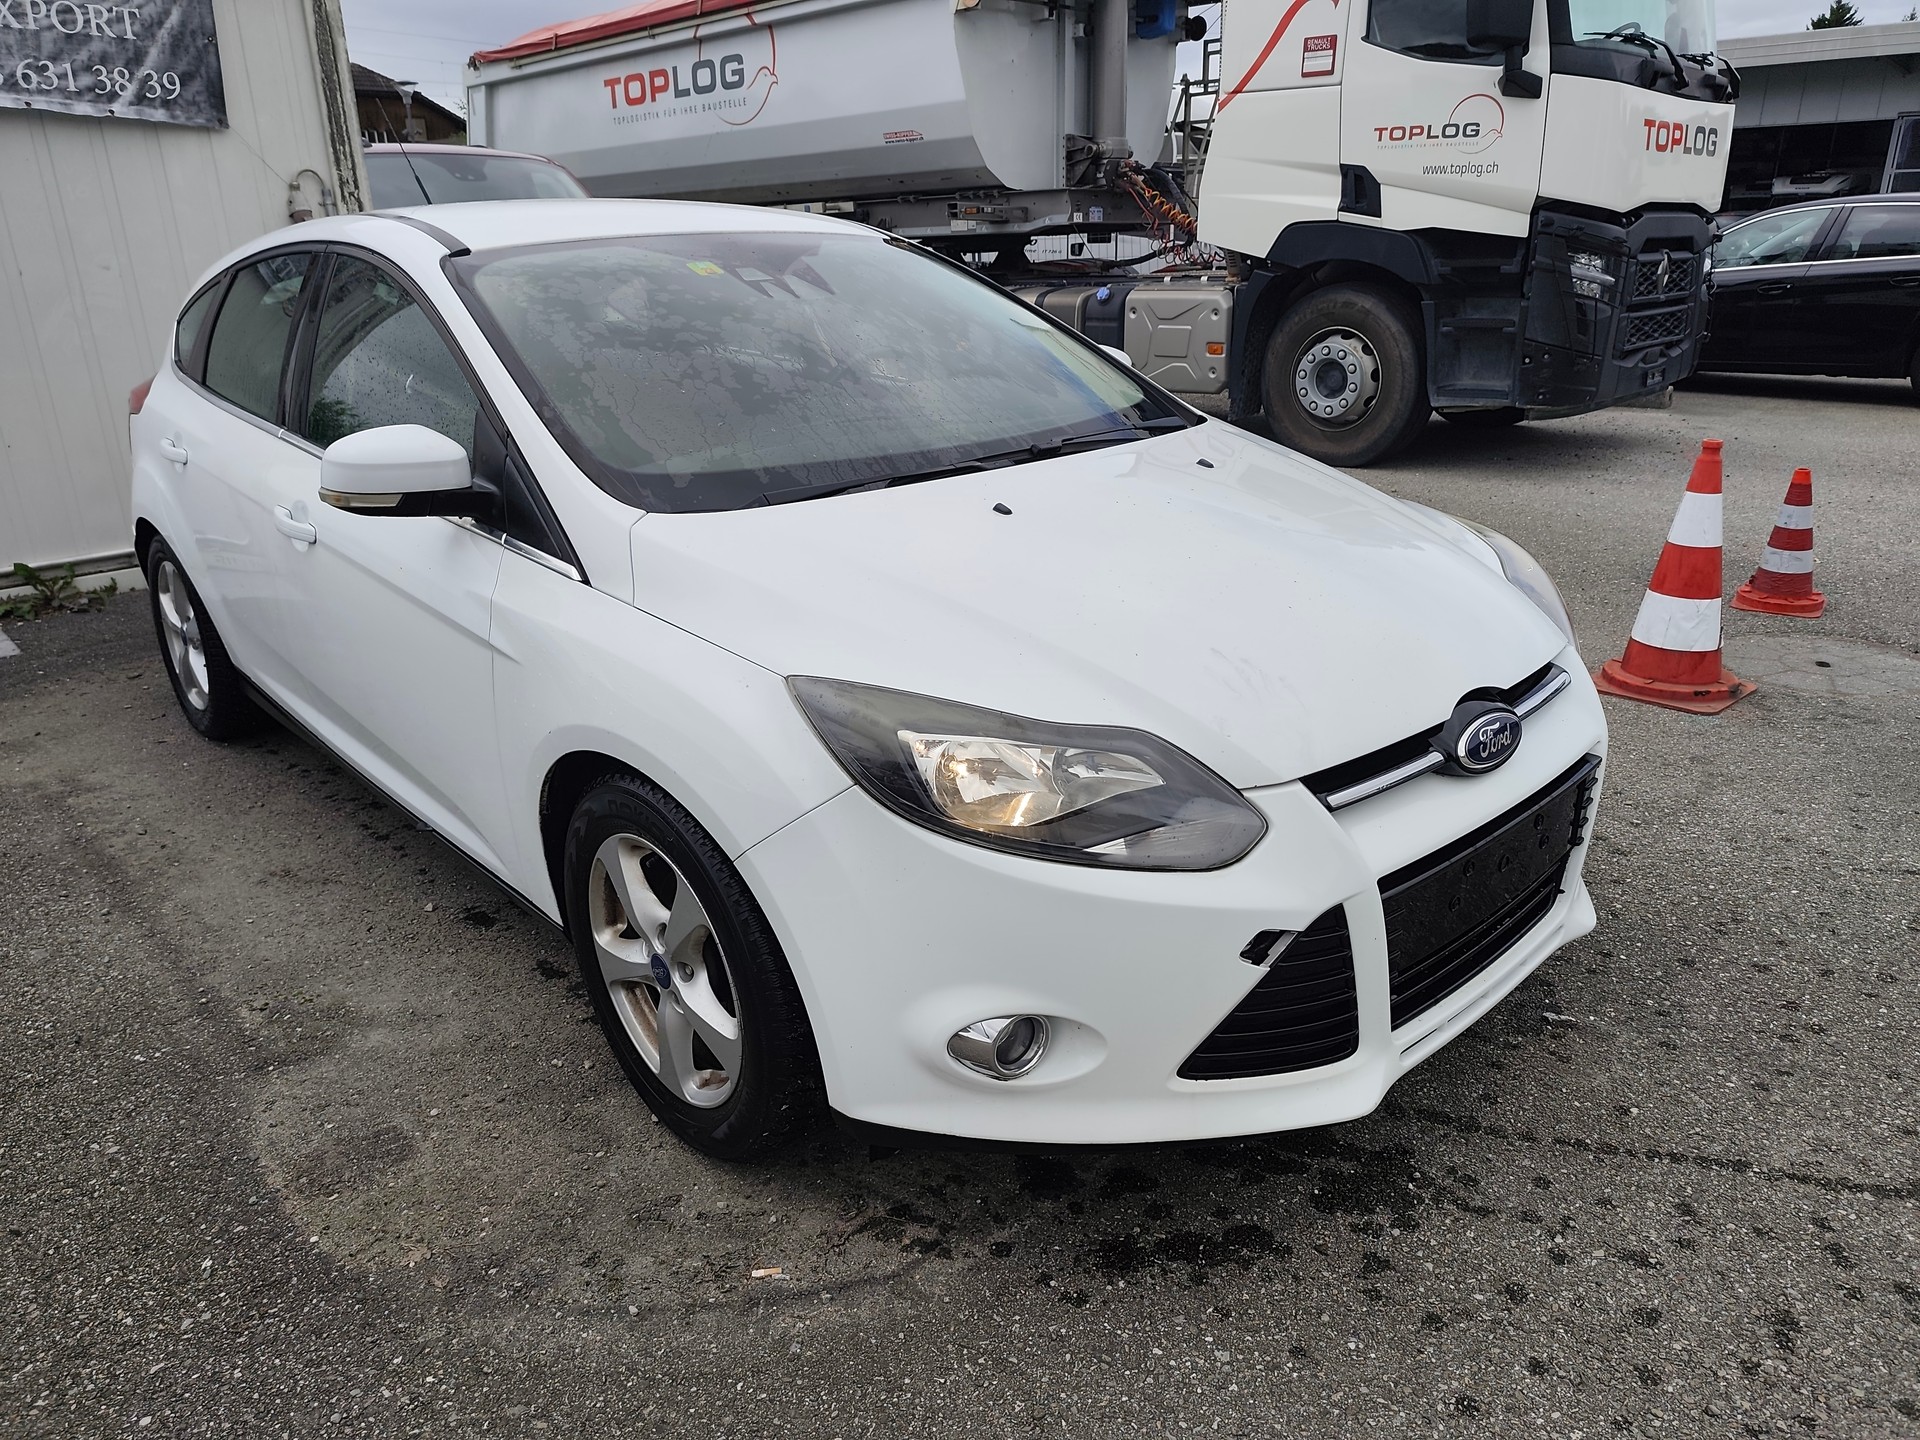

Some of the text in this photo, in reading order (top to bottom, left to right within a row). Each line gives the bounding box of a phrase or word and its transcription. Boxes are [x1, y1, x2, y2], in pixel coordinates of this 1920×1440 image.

[1307, 37, 1331, 45] RENAULT
[1307, 43, 1331, 51] TRUCKS
[16, 58, 80, 93] 631
[92, 64, 132, 95] 38
[143, 69, 182, 100] 39
[603, 53, 746, 110] TOPLOG
[613, 97, 747, 126] TOPLOGISTIK FÜR IHRE BAUSTELLE
[1373, 122, 1481, 142] TOPLOG
[1643, 118, 1718, 157] TOPLOG
[1422, 161, 1499, 178] www.toplog.ch
[1479, 721, 1513, 758] Ford
